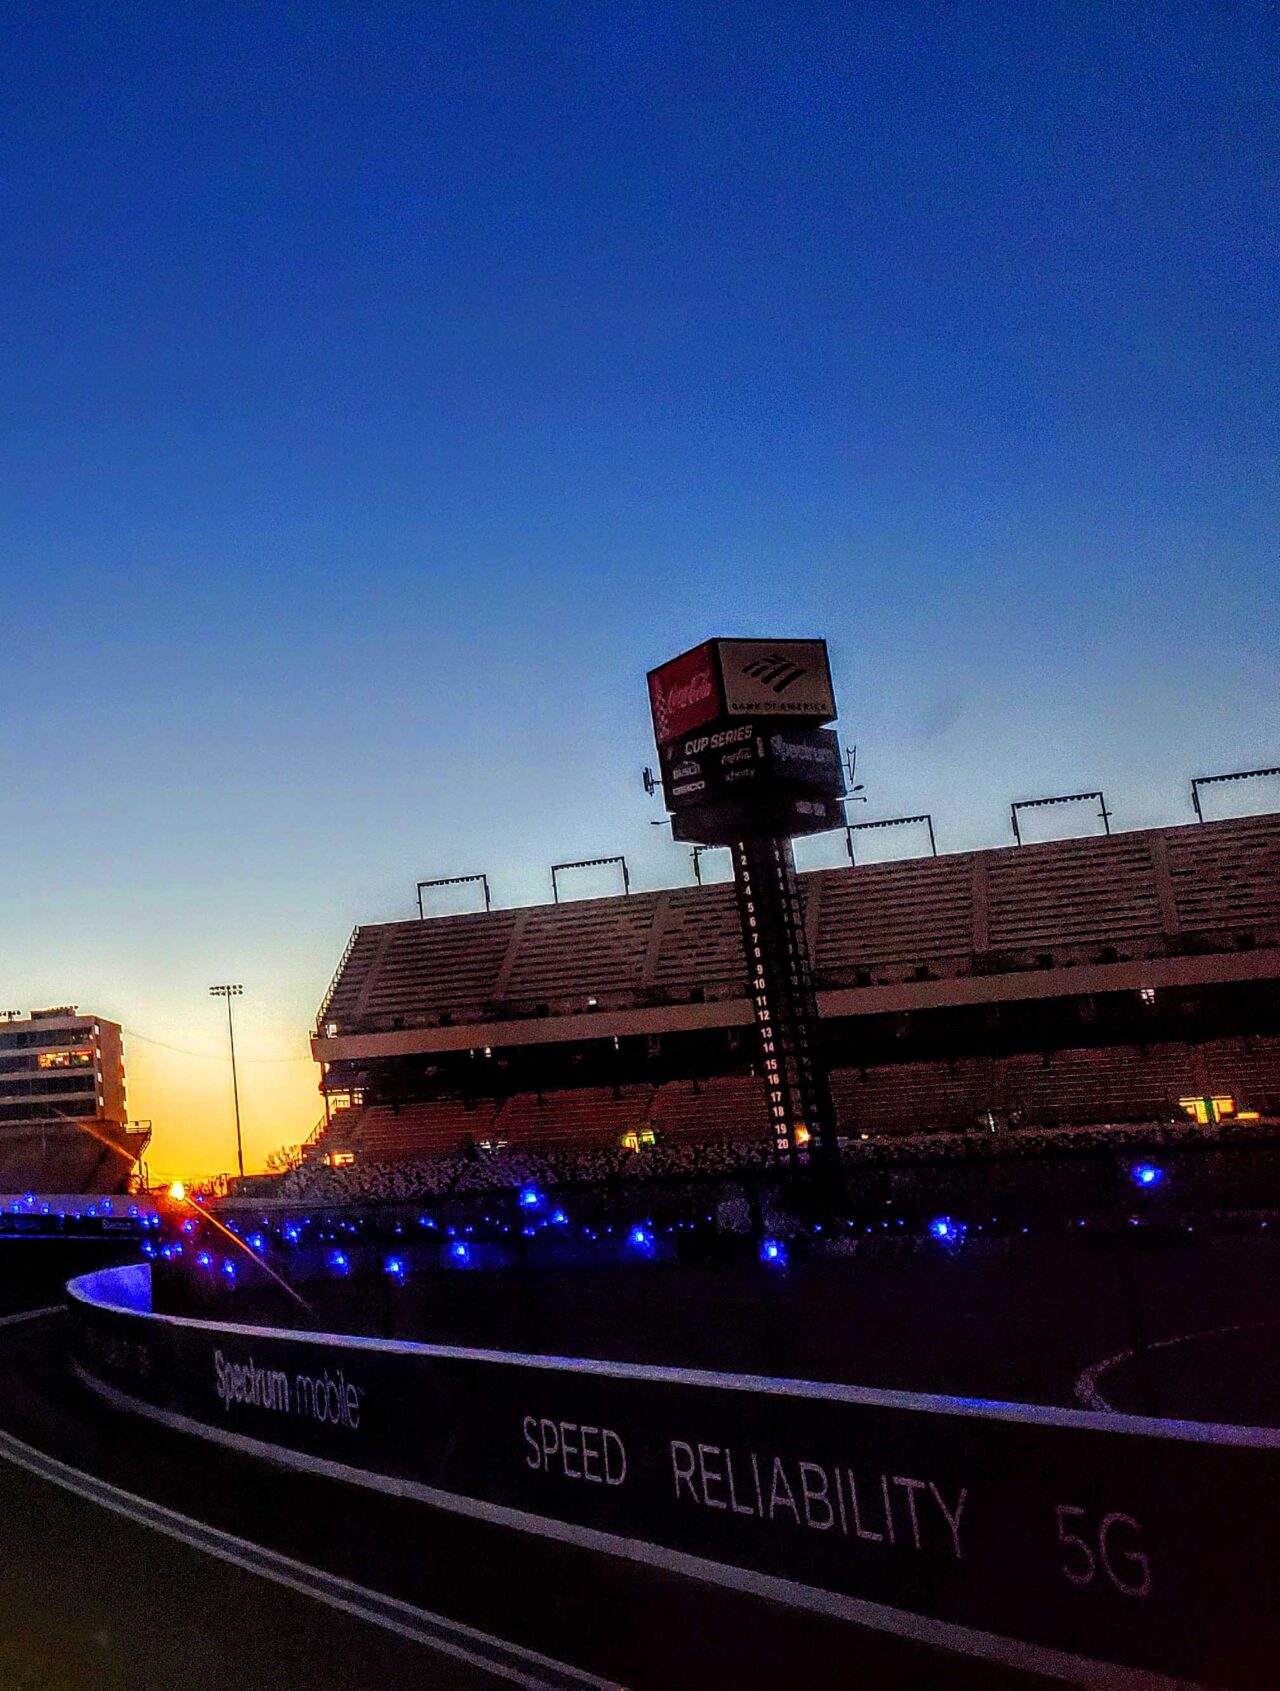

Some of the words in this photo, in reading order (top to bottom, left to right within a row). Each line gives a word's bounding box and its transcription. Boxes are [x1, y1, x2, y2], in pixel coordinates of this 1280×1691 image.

[685, 736, 709, 756] CUP
[711, 724, 753, 749] SERIES
[753, 978, 765, 990] 10
[756, 995, 767, 1007] 11
[758, 1009, 771, 1021] 12
[760, 1026, 772, 1038] 13
[763, 1041, 774, 1053] 14
[766, 1059, 777, 1070] 15
[768, 1073, 780, 1085] 16
[770, 1091, 782, 1102] 17
[772, 1105, 784, 1117] 18
[775, 1123, 787, 1135] 19
[776, 1138, 789, 1150] 20
[215, 1349, 289, 1412] Spectrum
[296, 1367, 360, 1430] mobile
[522, 1414, 628, 1486] SPEED
[670, 1438, 968, 1560] RELIABILITY
[1056, 1503, 1152, 1598] 5G
